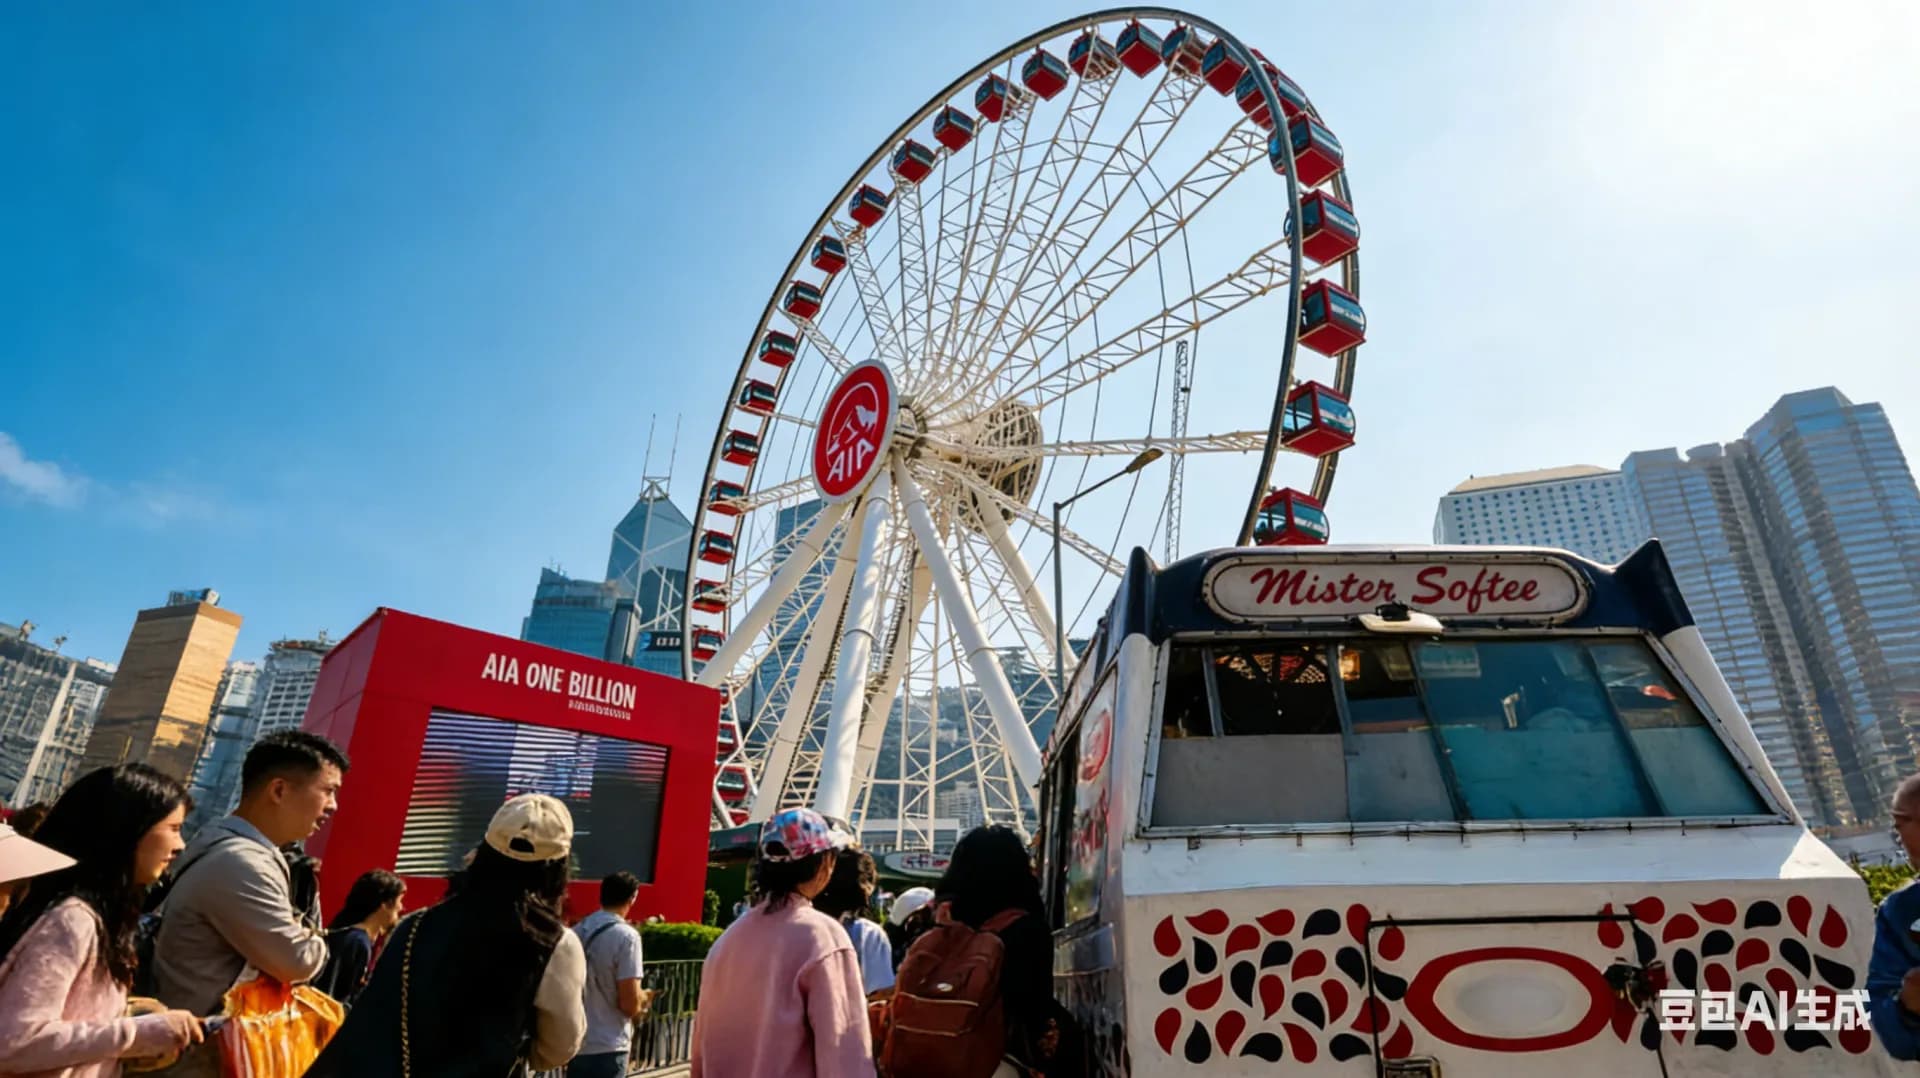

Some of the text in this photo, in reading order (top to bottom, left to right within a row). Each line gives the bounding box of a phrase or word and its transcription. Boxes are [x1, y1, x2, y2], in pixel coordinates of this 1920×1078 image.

[1250, 566, 1540, 614] Mister Softee
[481, 652, 519, 686] AIA
[525, 662, 565, 693] ONE
[567, 670, 637, 710] BILLION
